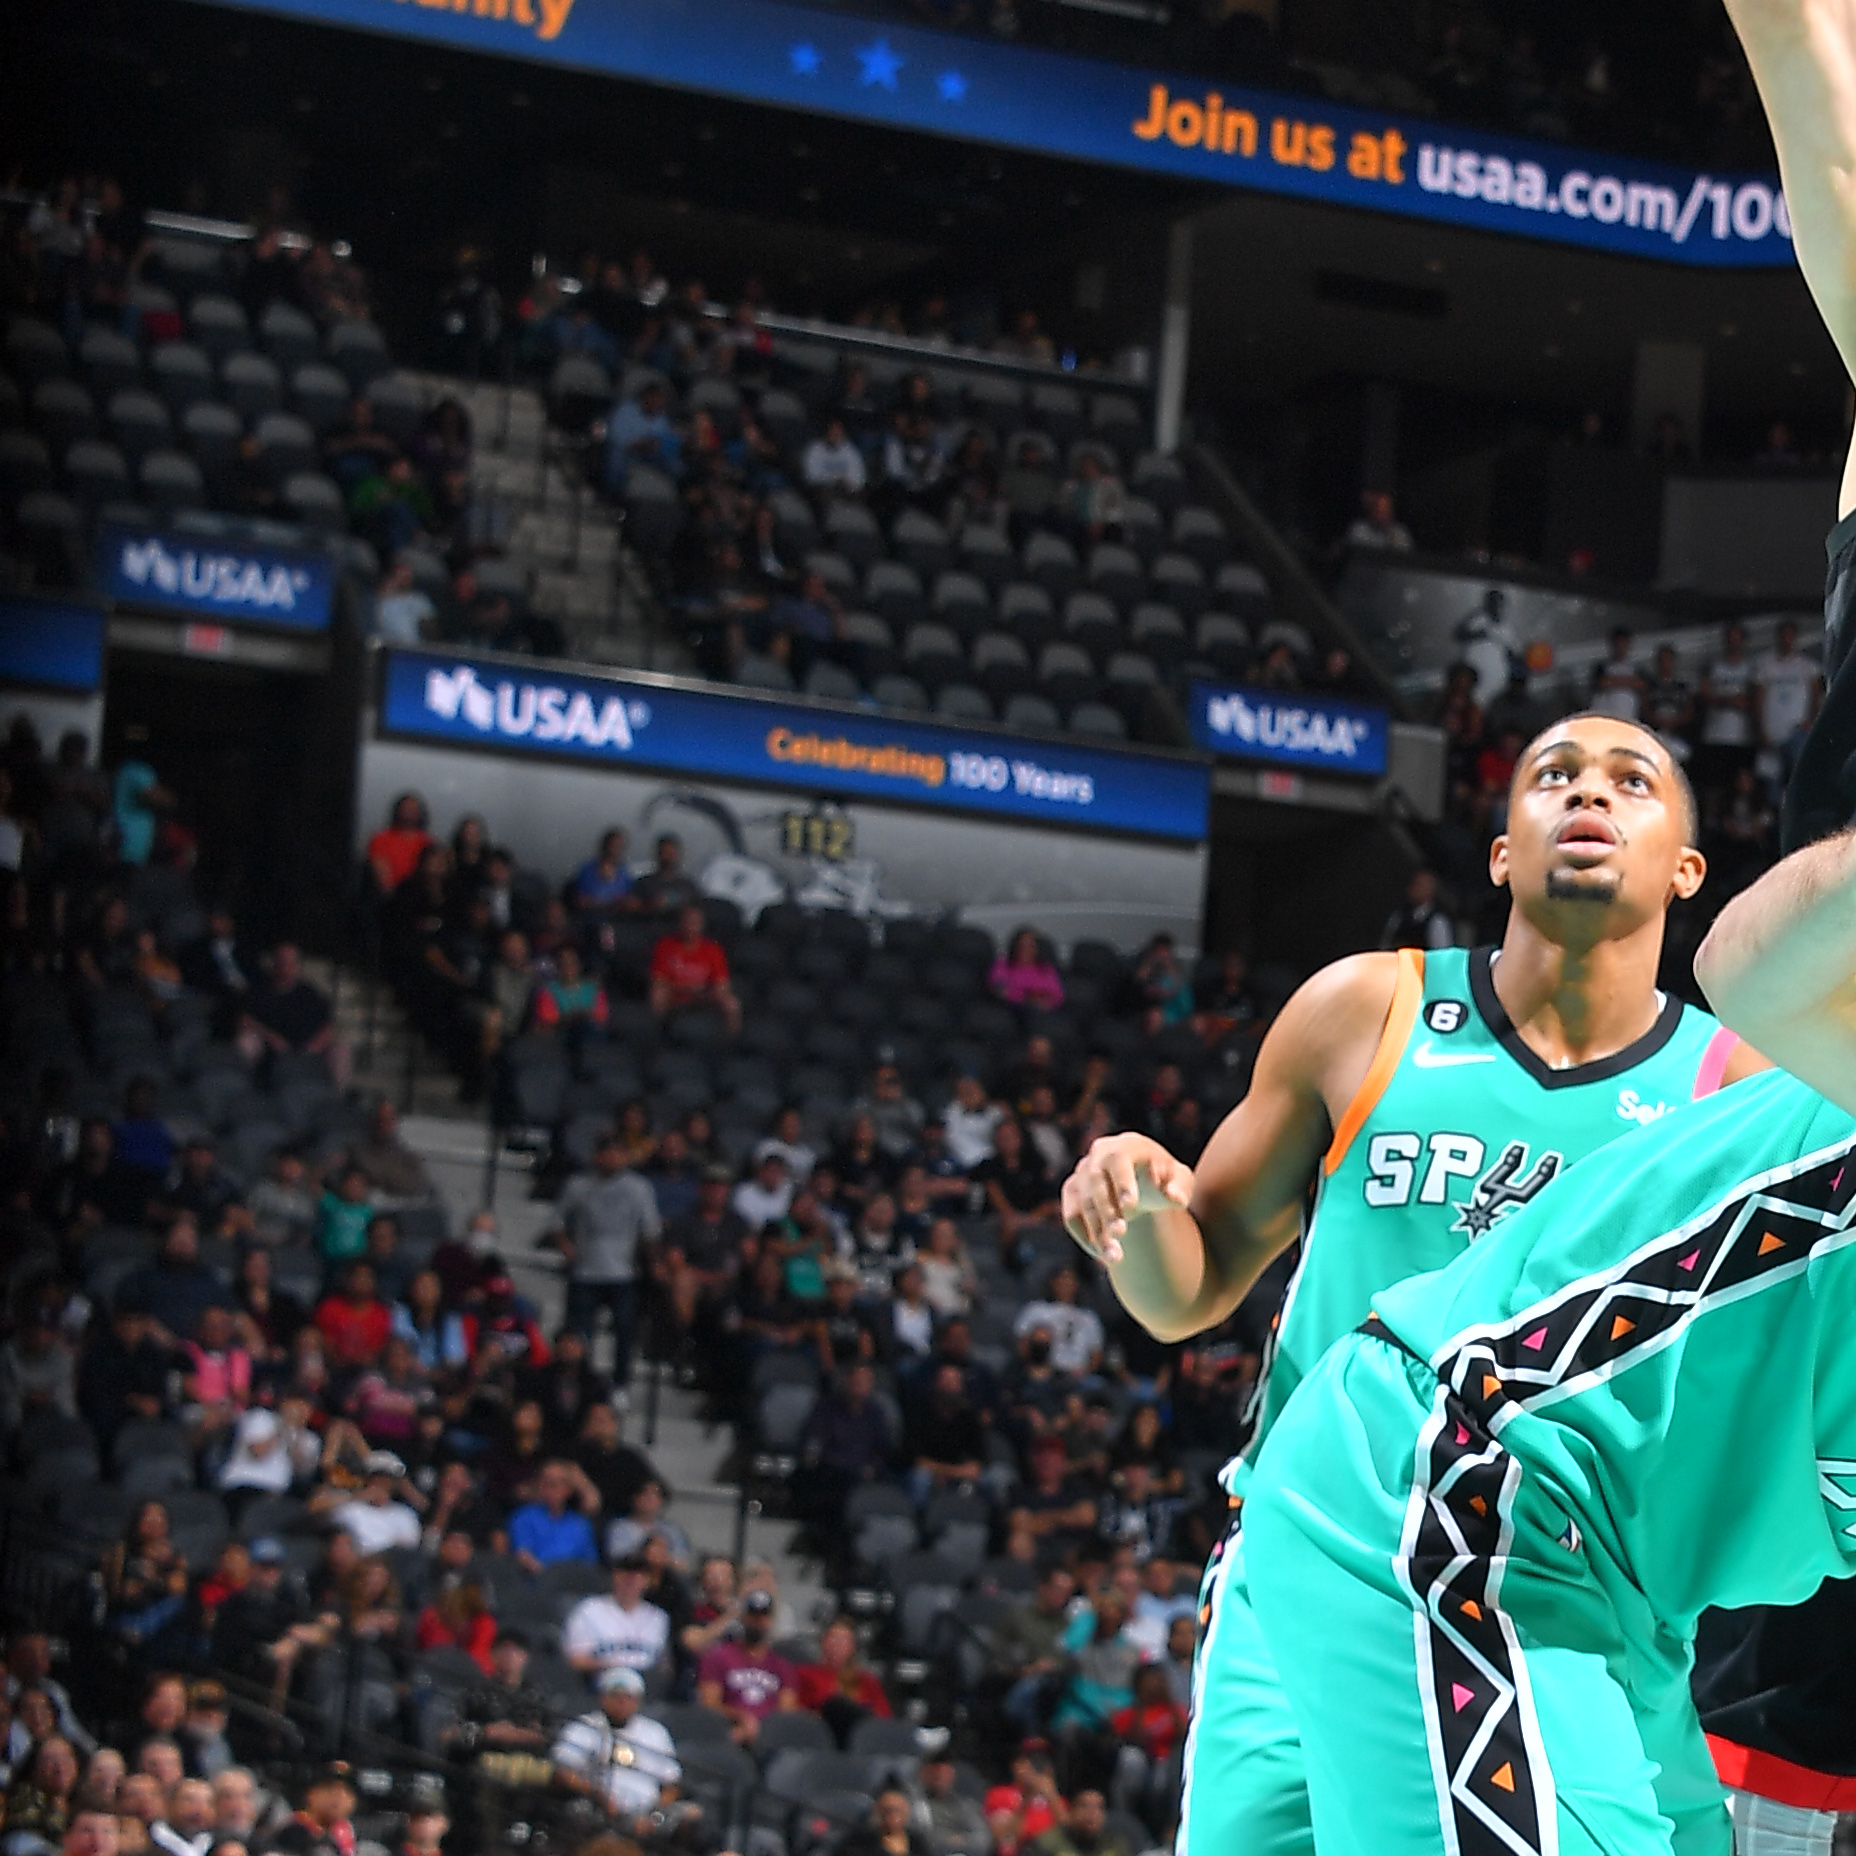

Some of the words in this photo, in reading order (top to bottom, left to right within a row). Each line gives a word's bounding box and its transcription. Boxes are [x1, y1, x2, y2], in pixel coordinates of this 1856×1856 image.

[1133, 83, 1259, 158] Join
[1270, 116, 1337, 173] us
[1346, 127, 1408, 186] at
[500, 682, 634, 751] USAA
[766, 725, 946, 787] Celebrating
[950, 749, 1009, 794] 100
[1012, 760, 1095, 805] Years
[1429, 1002, 1462, 1032] 6
